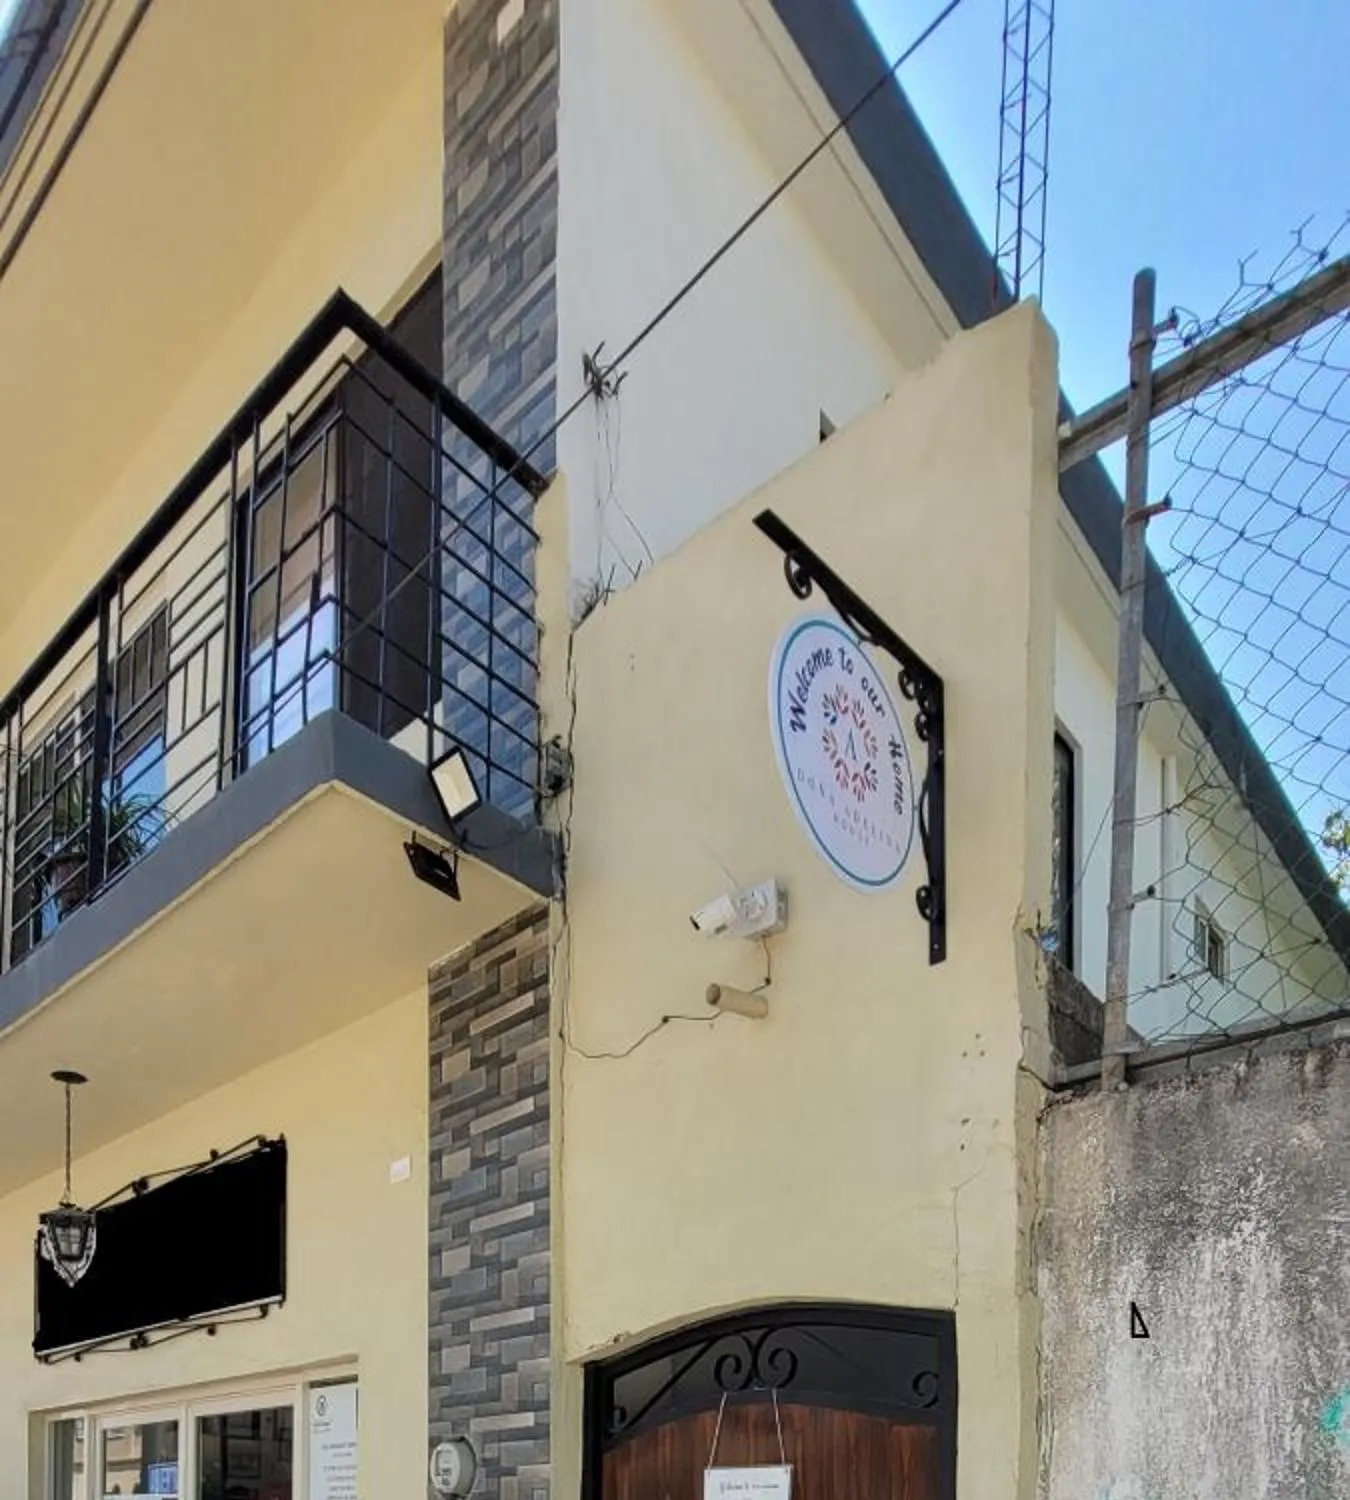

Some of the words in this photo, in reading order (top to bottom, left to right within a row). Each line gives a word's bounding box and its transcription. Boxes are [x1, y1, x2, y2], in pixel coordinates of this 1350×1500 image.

[788, 646, 833, 733] Welcome
[837, 646, 854, 675] to
[861, 677, 886, 717] our
[887, 733, 904, 816] Home
